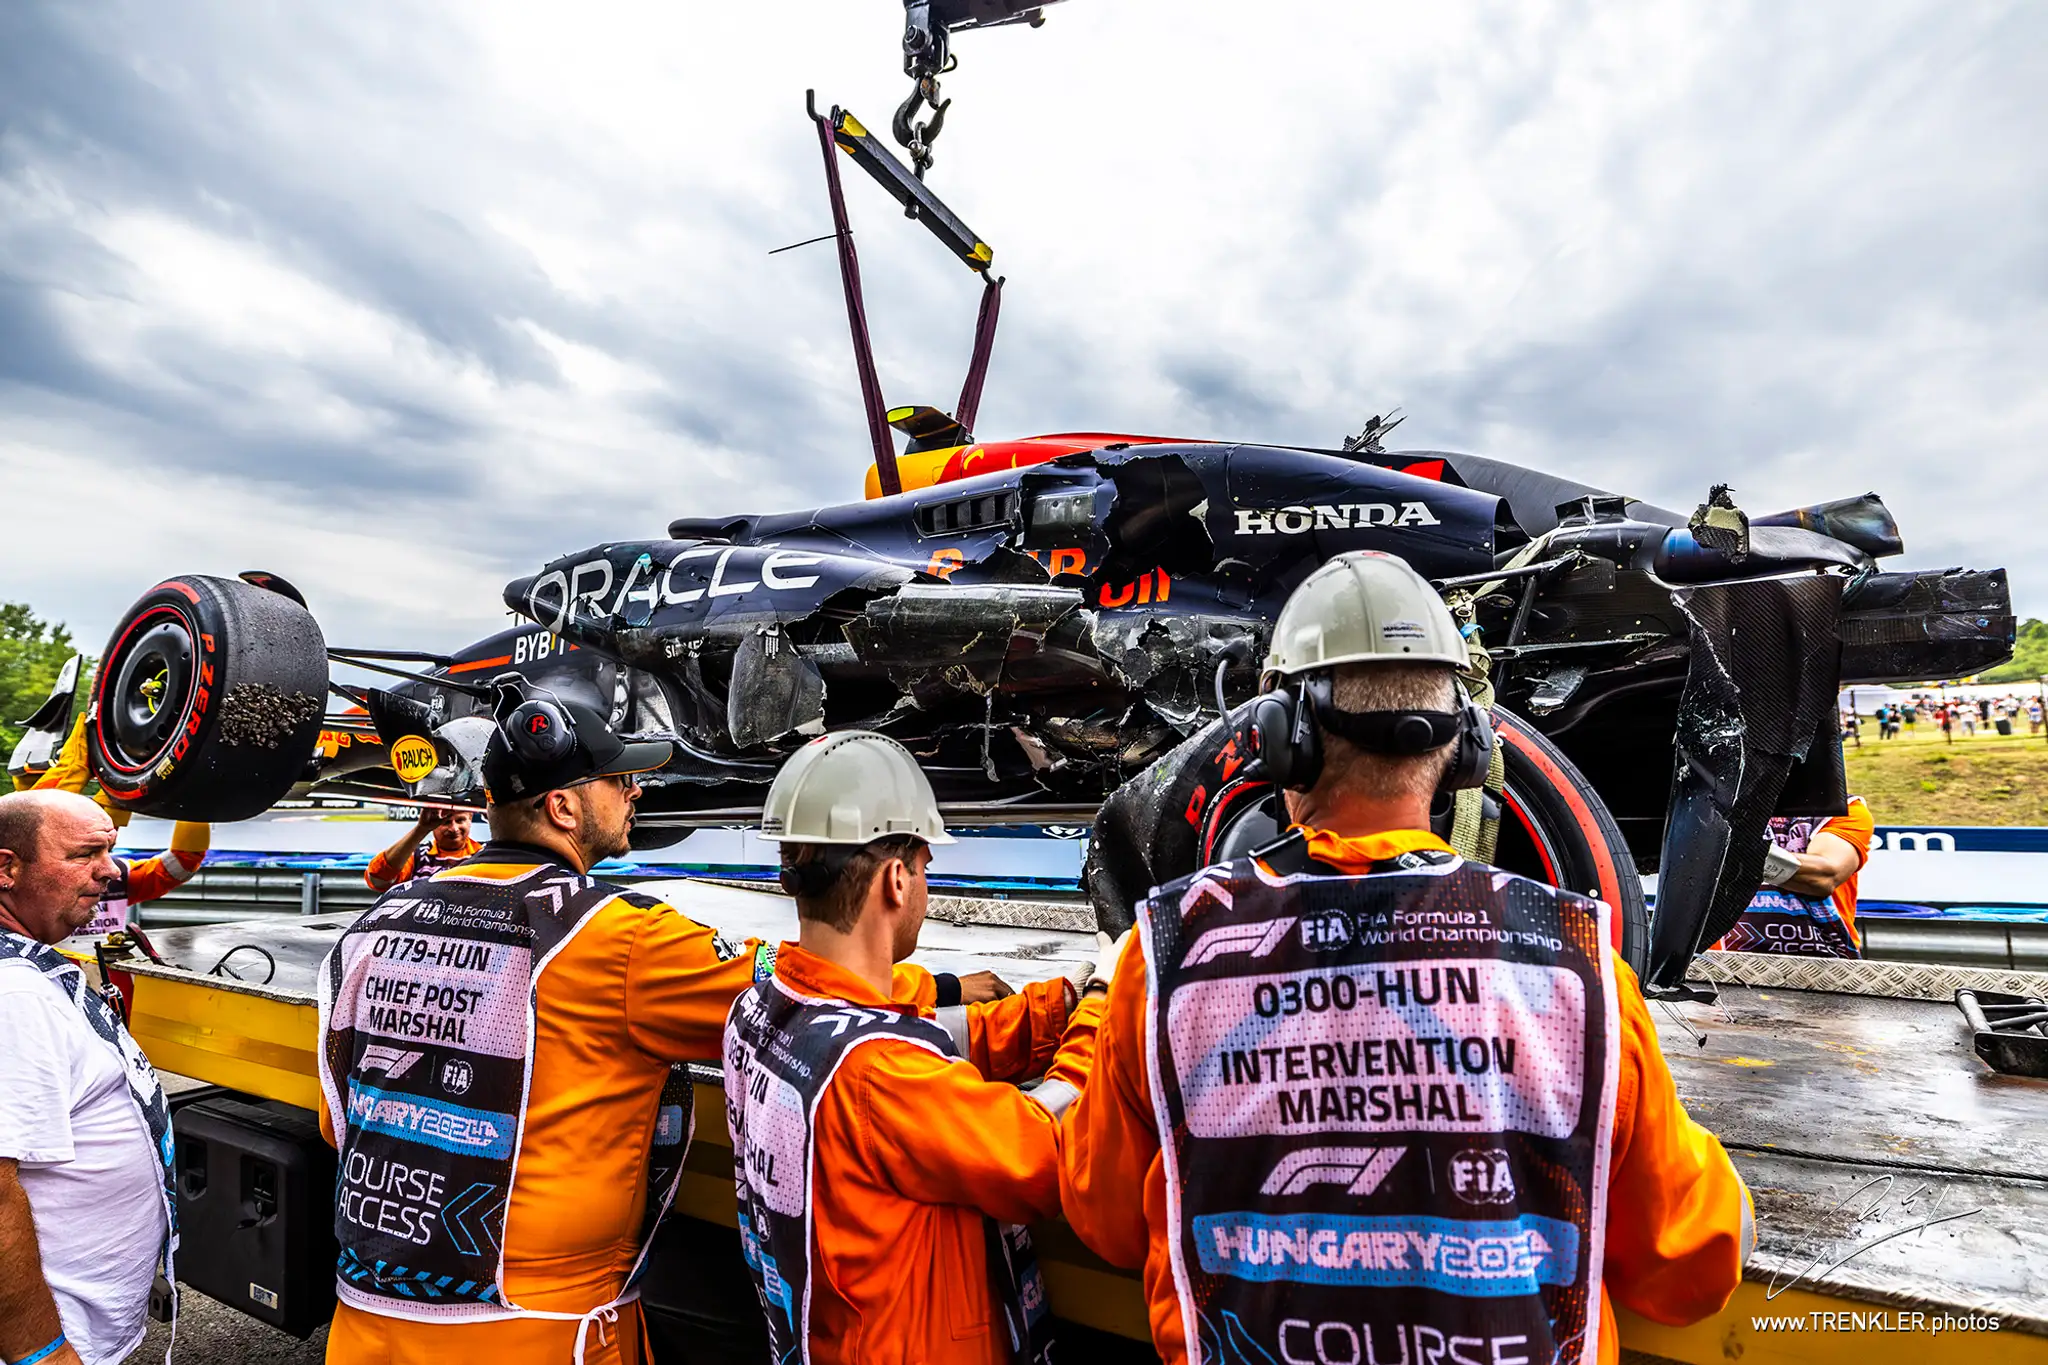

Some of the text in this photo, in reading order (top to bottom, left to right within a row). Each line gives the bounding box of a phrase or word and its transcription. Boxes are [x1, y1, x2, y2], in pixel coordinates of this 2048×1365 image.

[1234, 502, 1441, 535] HONDA
[528, 546, 827, 634] ORACLE
[402, 747, 433, 769] RAUCH
[442, 914, 473, 925] World
[464, 906, 504, 918] Formula
[1392, 909, 1476, 925] Formula
[1478, 909, 1492, 924] 1
[372, 935, 491, 972] 0179-HUN
[1360, 926, 1563, 952] World Championship
[365, 976, 483, 1015] CHIEF POST
[1254, 968, 1480, 1019] 0300-HUN
[368, 1005, 466, 1045] MARSHAL
[1221, 1036, 1517, 1086] INTERVENTION
[1278, 1083, 1482, 1126] MARSHAL
[338, 1186, 437, 1246] ACCESS
[1279, 1318, 1528, 1365] COURSE
